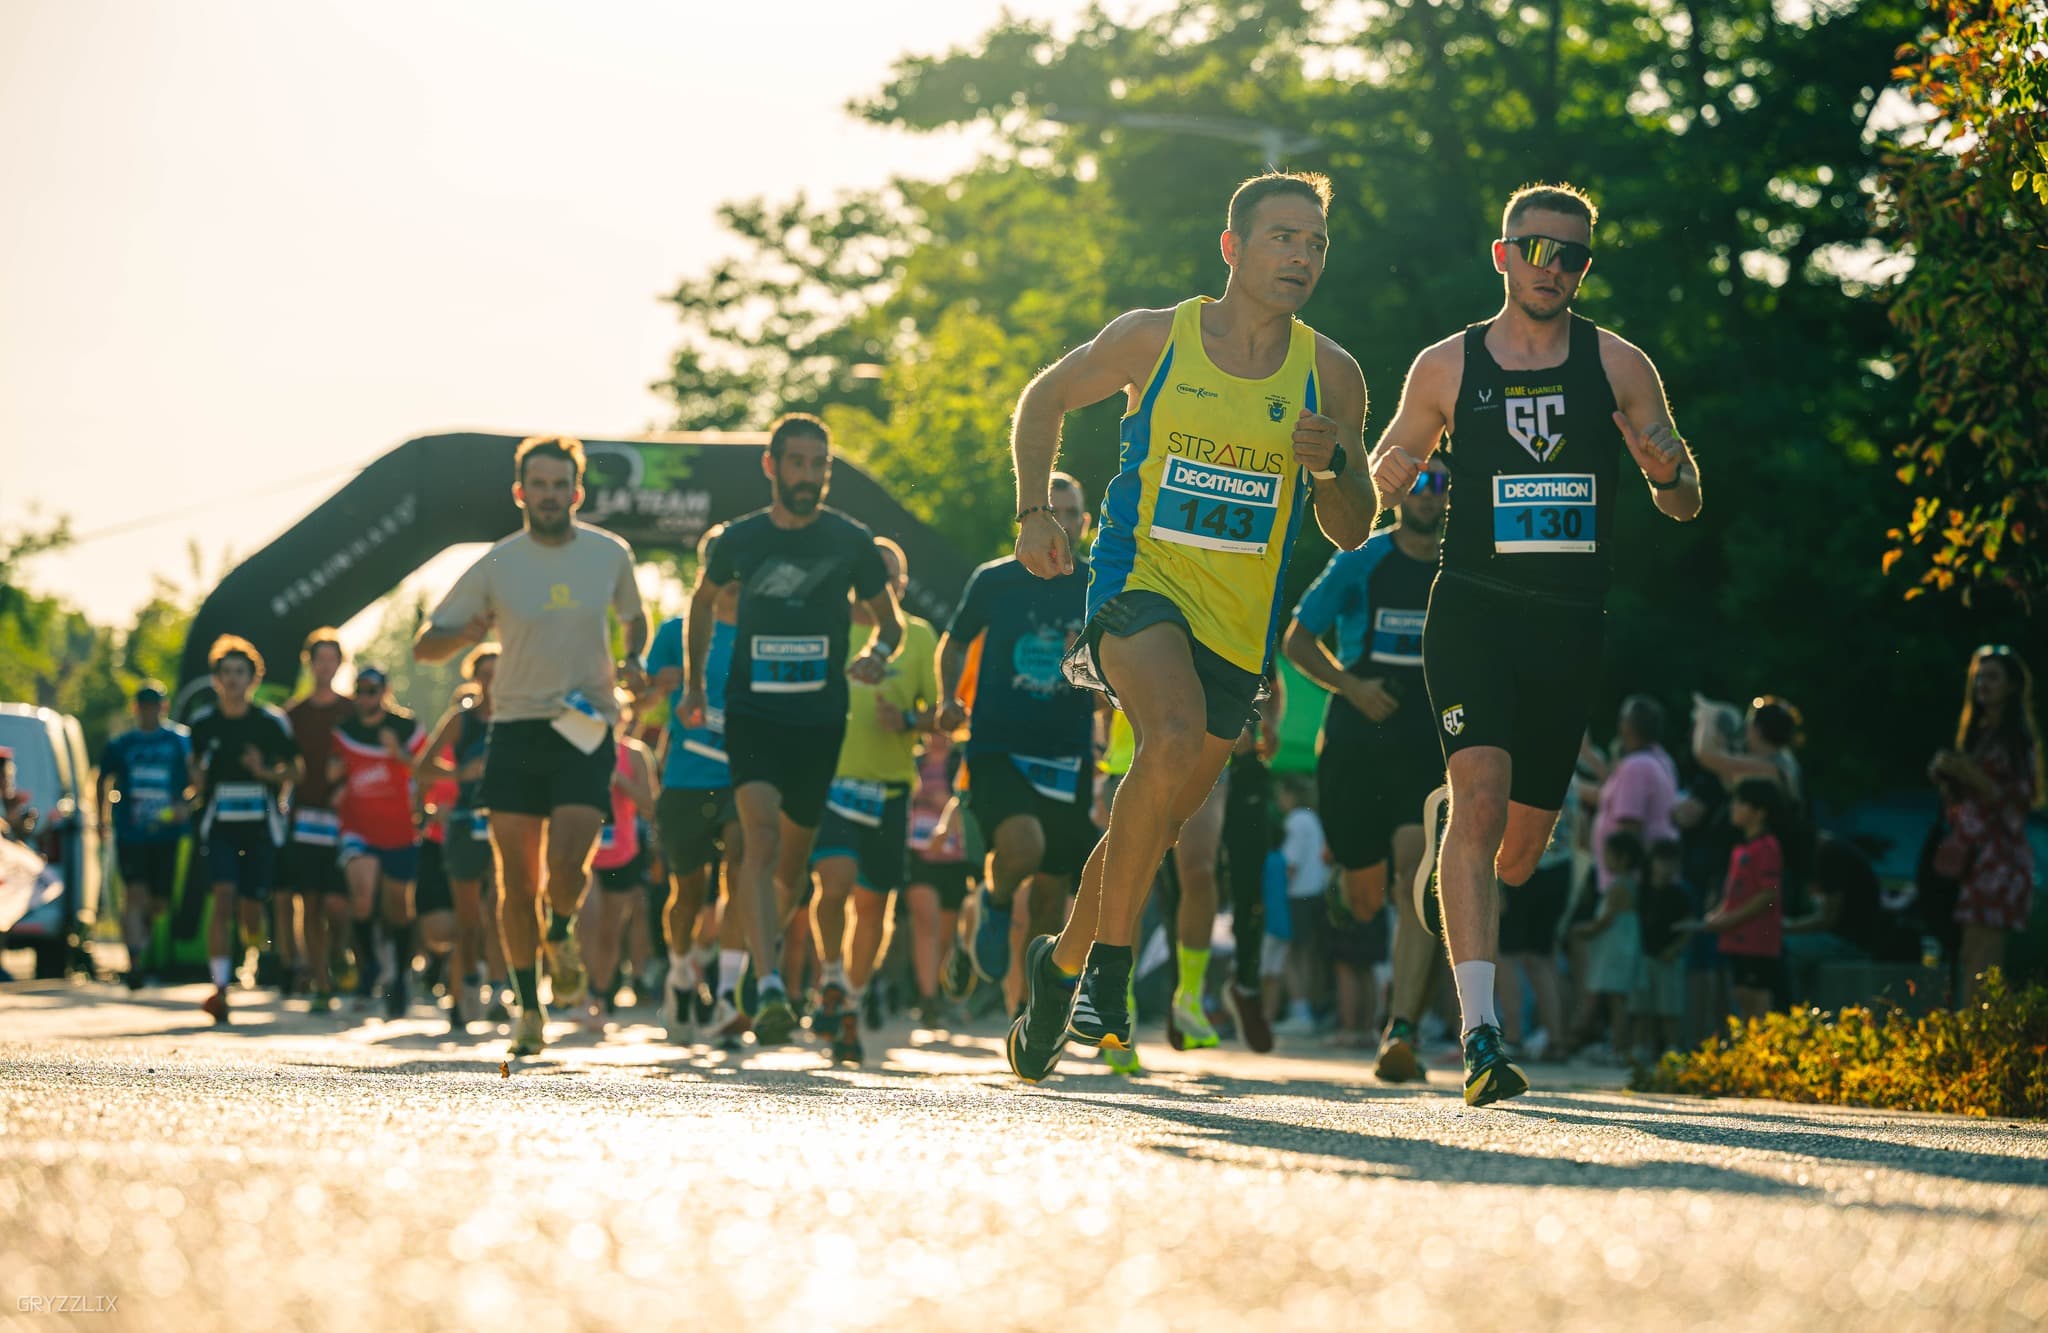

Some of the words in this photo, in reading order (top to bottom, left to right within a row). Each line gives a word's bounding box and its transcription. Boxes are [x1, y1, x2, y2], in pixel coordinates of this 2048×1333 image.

[1505, 387, 1526, 396] GAME
[1505, 395, 1565, 462] GC
[1167, 431, 1284, 474] STRATUS
[1174, 466, 1270, 498] DECATHLON
[1505, 482, 1588, 498] DECATHLON
[1180, 498, 1254, 539] 143
[1516, 508, 1582, 538] 130
